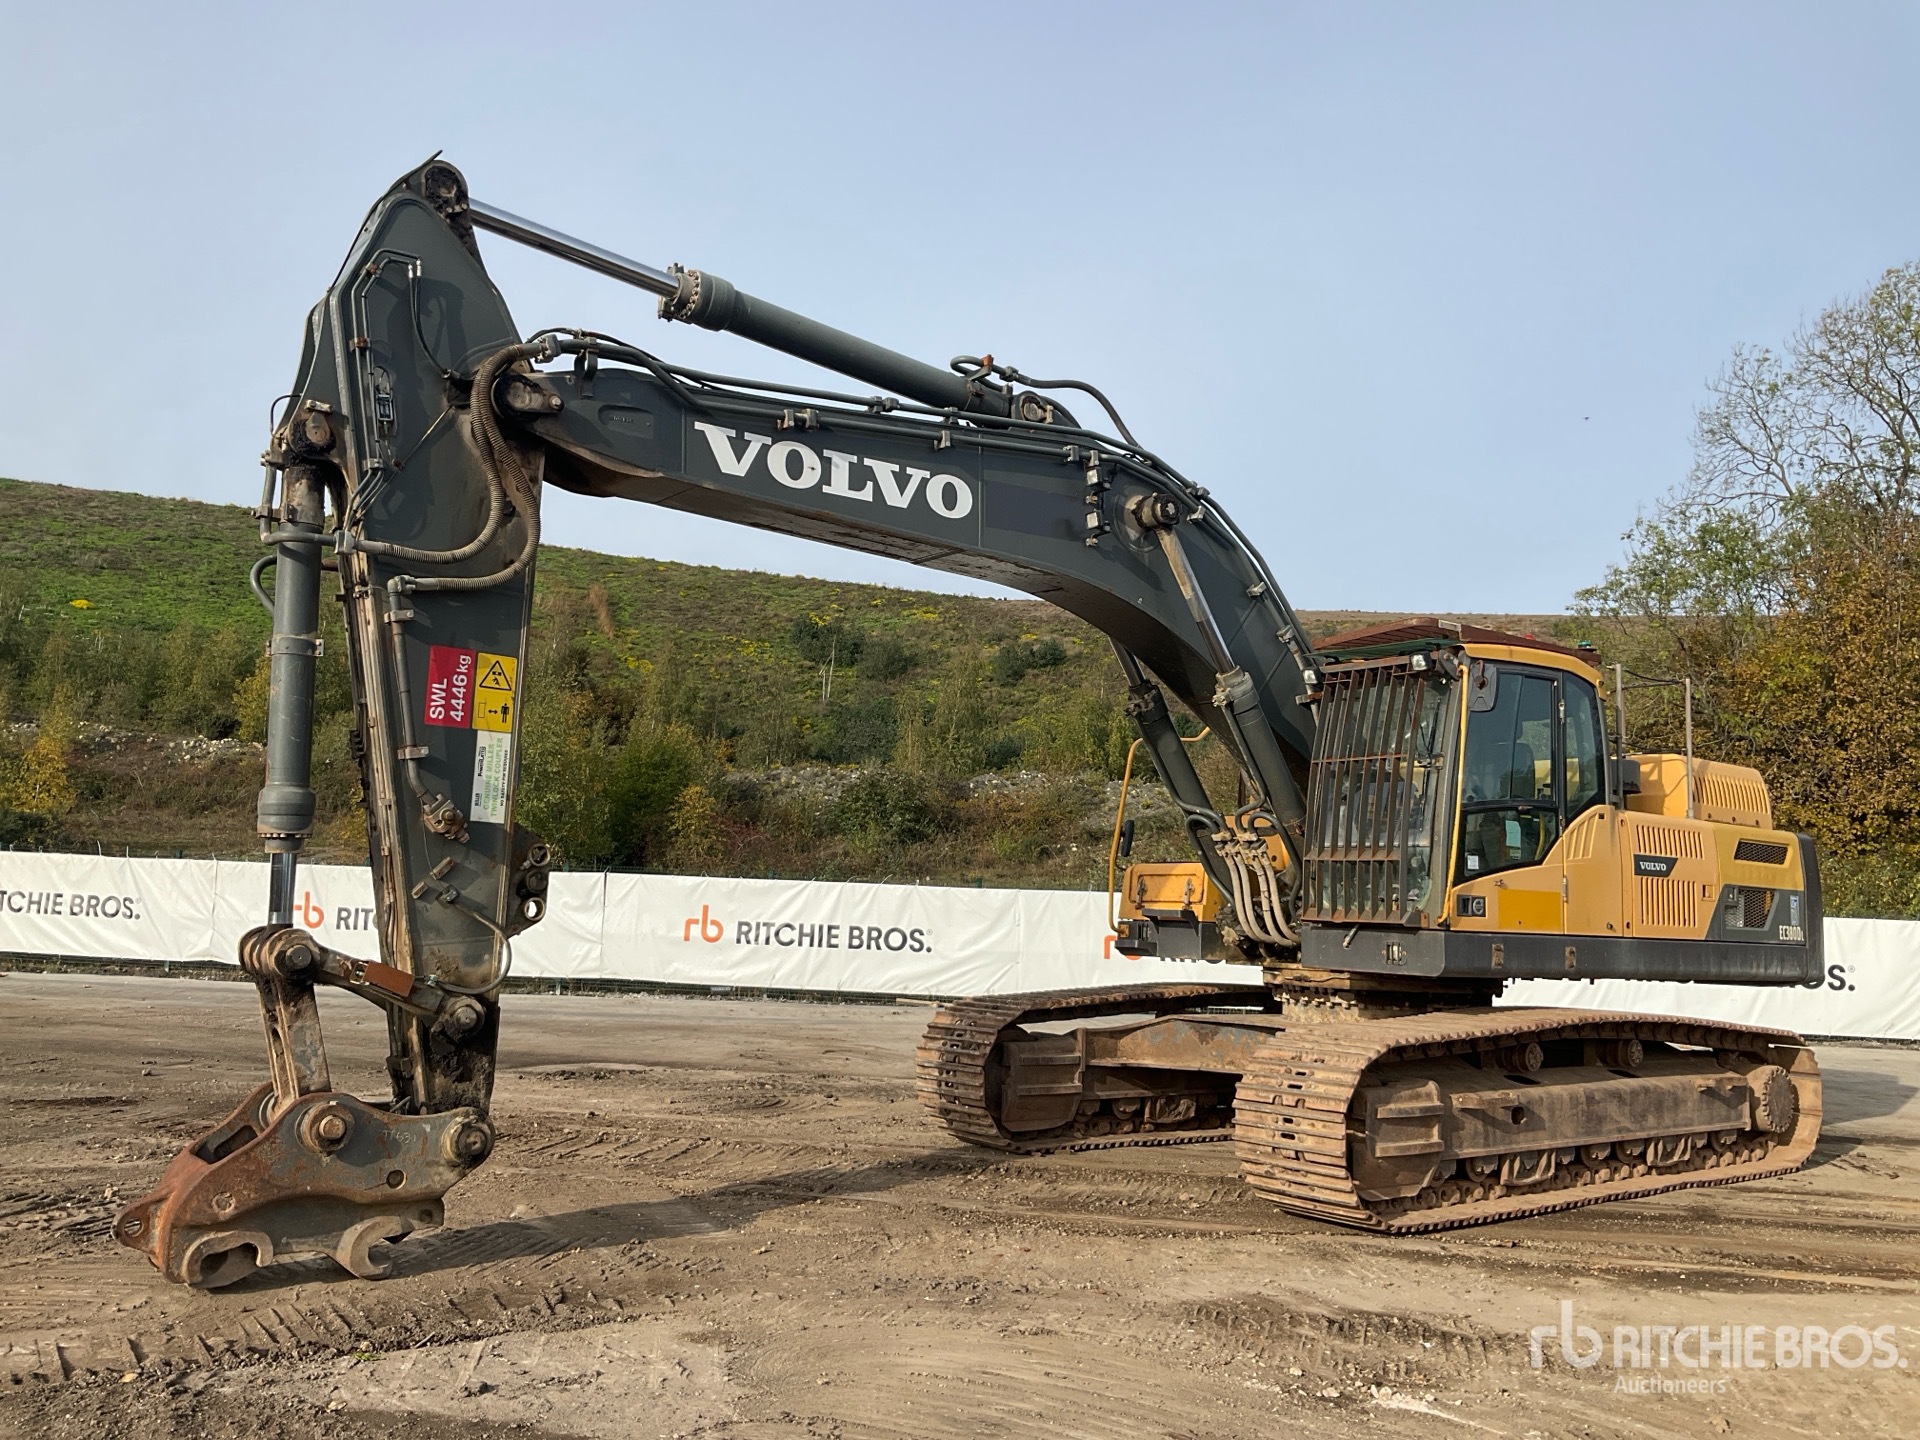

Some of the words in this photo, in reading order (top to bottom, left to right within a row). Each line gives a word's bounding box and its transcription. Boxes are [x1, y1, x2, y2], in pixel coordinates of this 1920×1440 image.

[694, 422, 973, 518] VOLVO
[429, 678, 447, 720] SWL
[486, 743, 494, 772] MILLER
[494, 737, 503, 774] COUPLER
[483, 774, 492, 809] GENUINE
[491, 776, 500, 817] TWINLOCK
[1640, 861, 1667, 871] VOLVO
[69, 894, 141, 920] BROS.
[684, 904, 724, 943] rb
[736, 920, 840, 948] RITCHIE
[848, 926, 932, 953] BROS.
